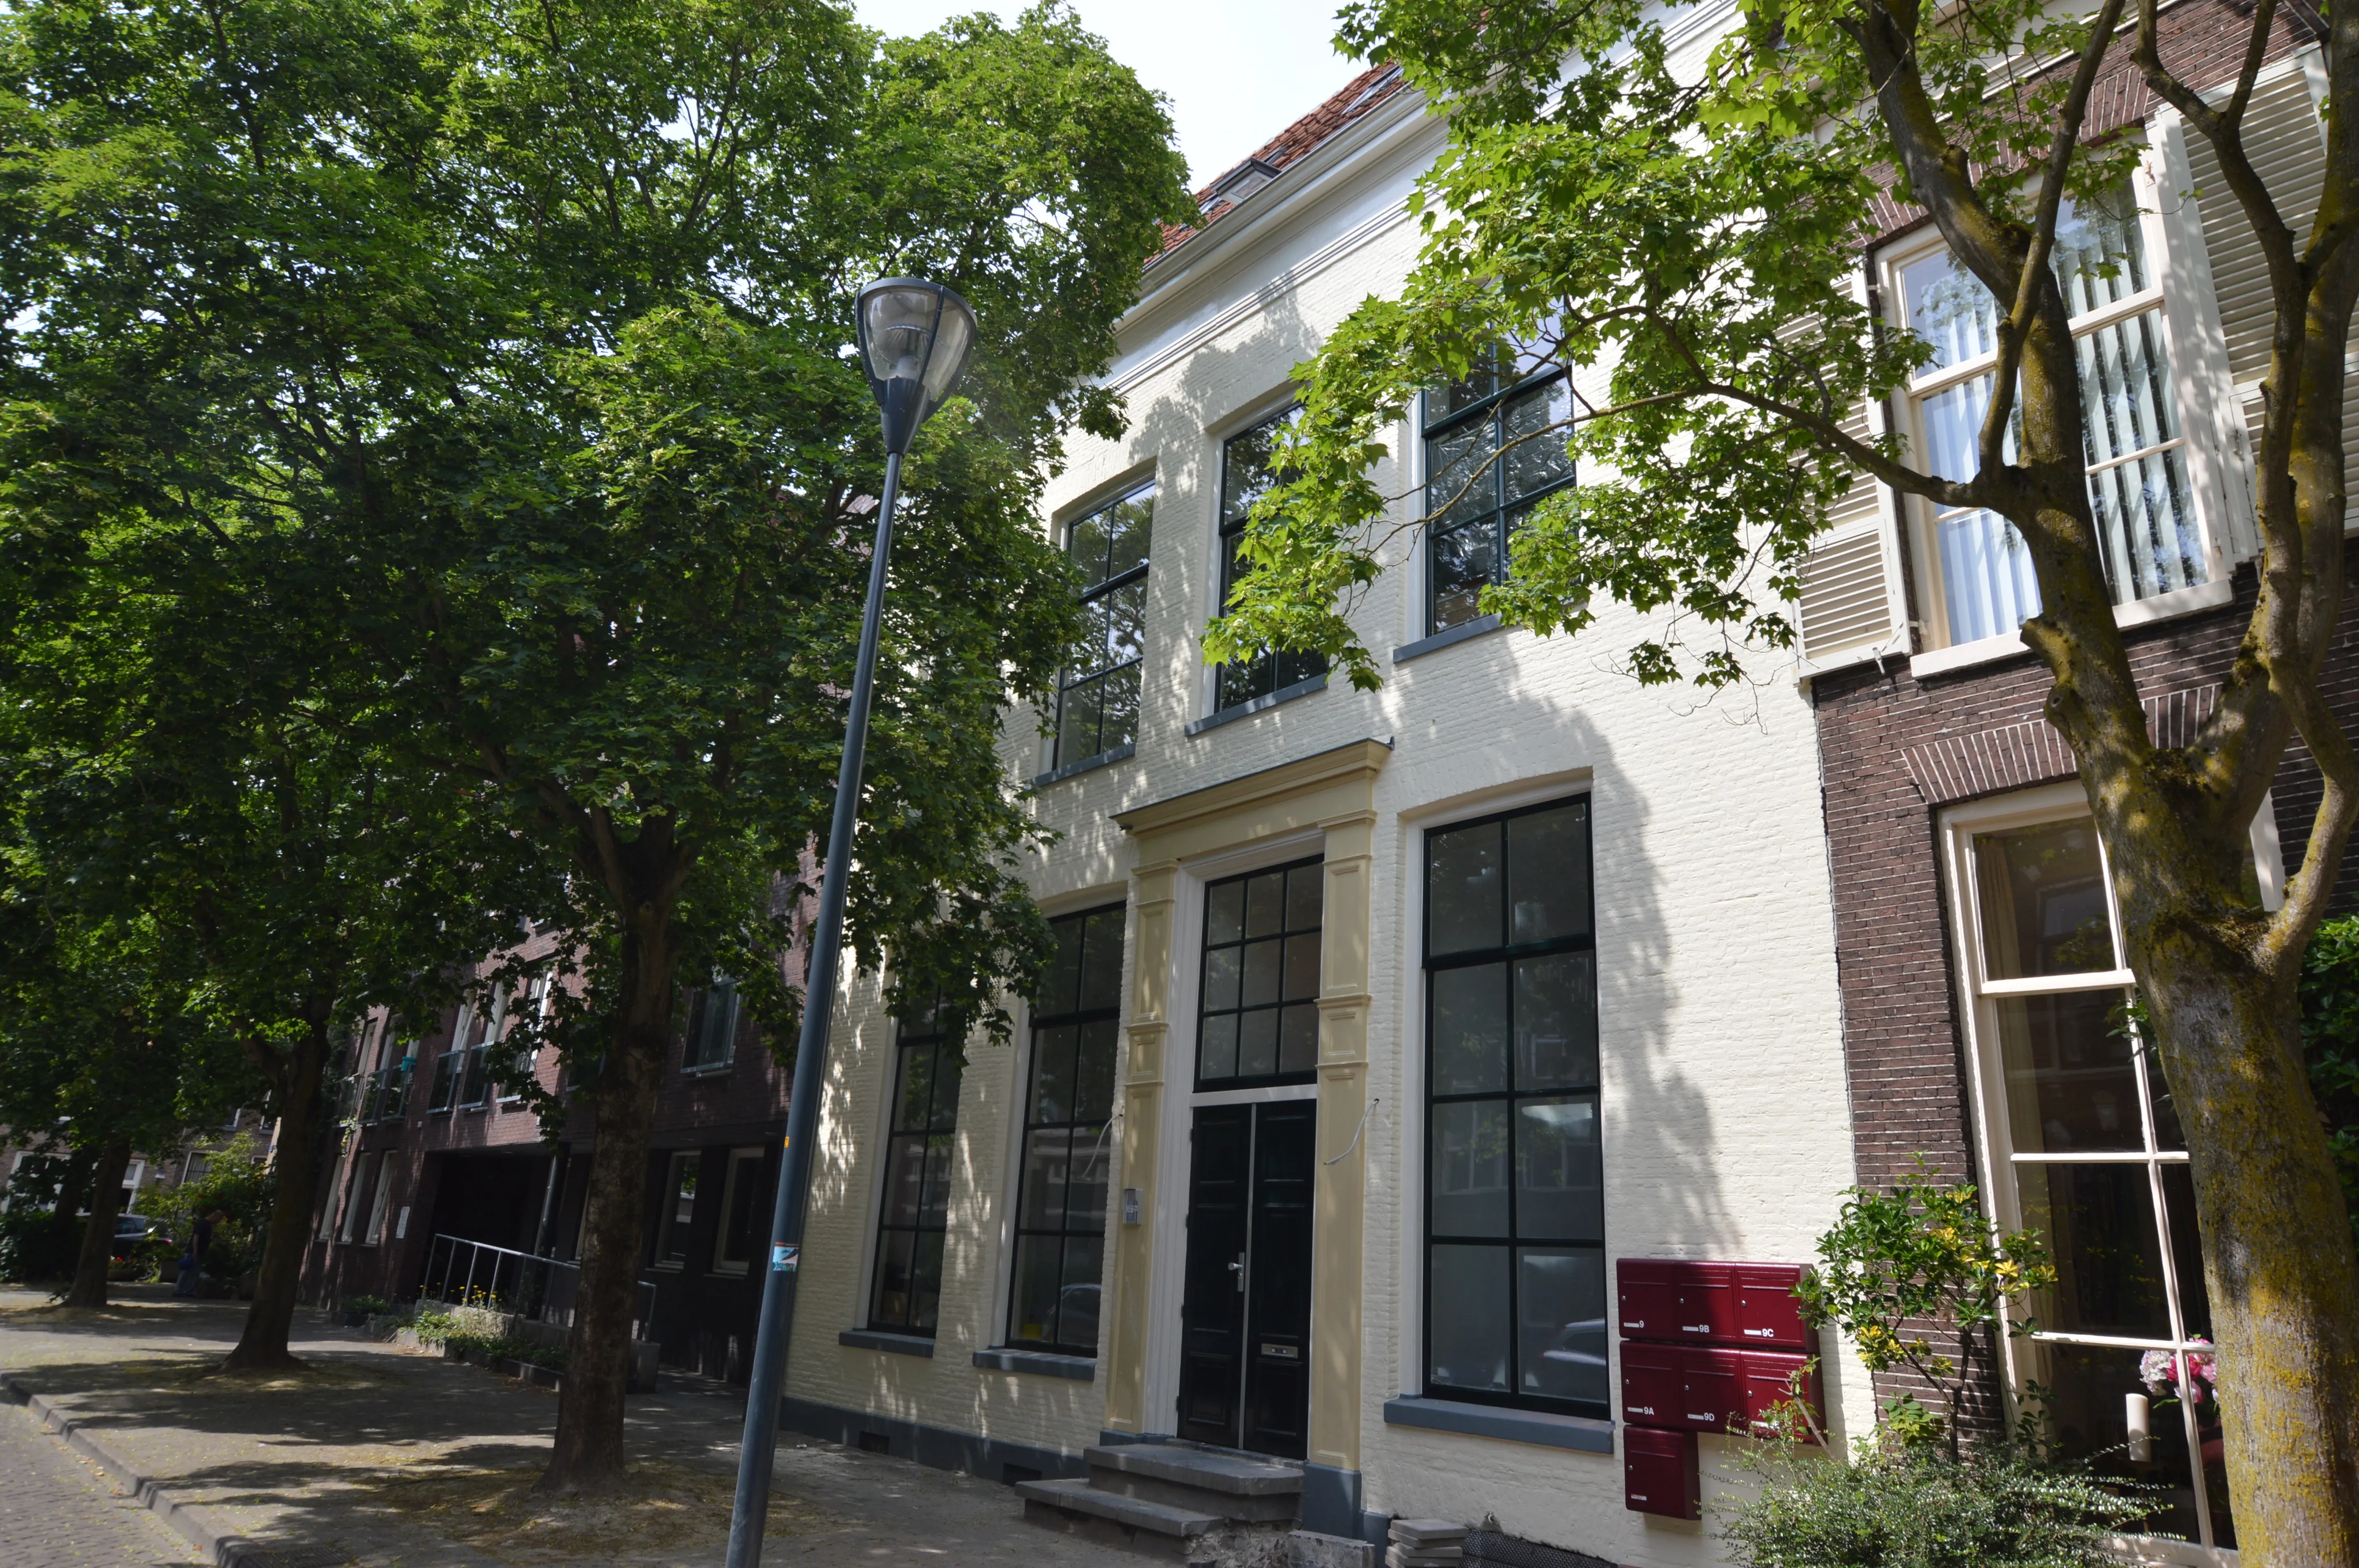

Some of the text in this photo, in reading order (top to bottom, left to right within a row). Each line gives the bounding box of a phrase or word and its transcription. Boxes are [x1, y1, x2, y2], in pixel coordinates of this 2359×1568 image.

[1639, 1320, 1644, 1328] 9
[1699, 1324, 1710, 1333] 9B
[1762, 1328, 1774, 1338] 9C
[1644, 1406, 1654, 1415] 9A
[1704, 1412, 1715, 1422] 9D
